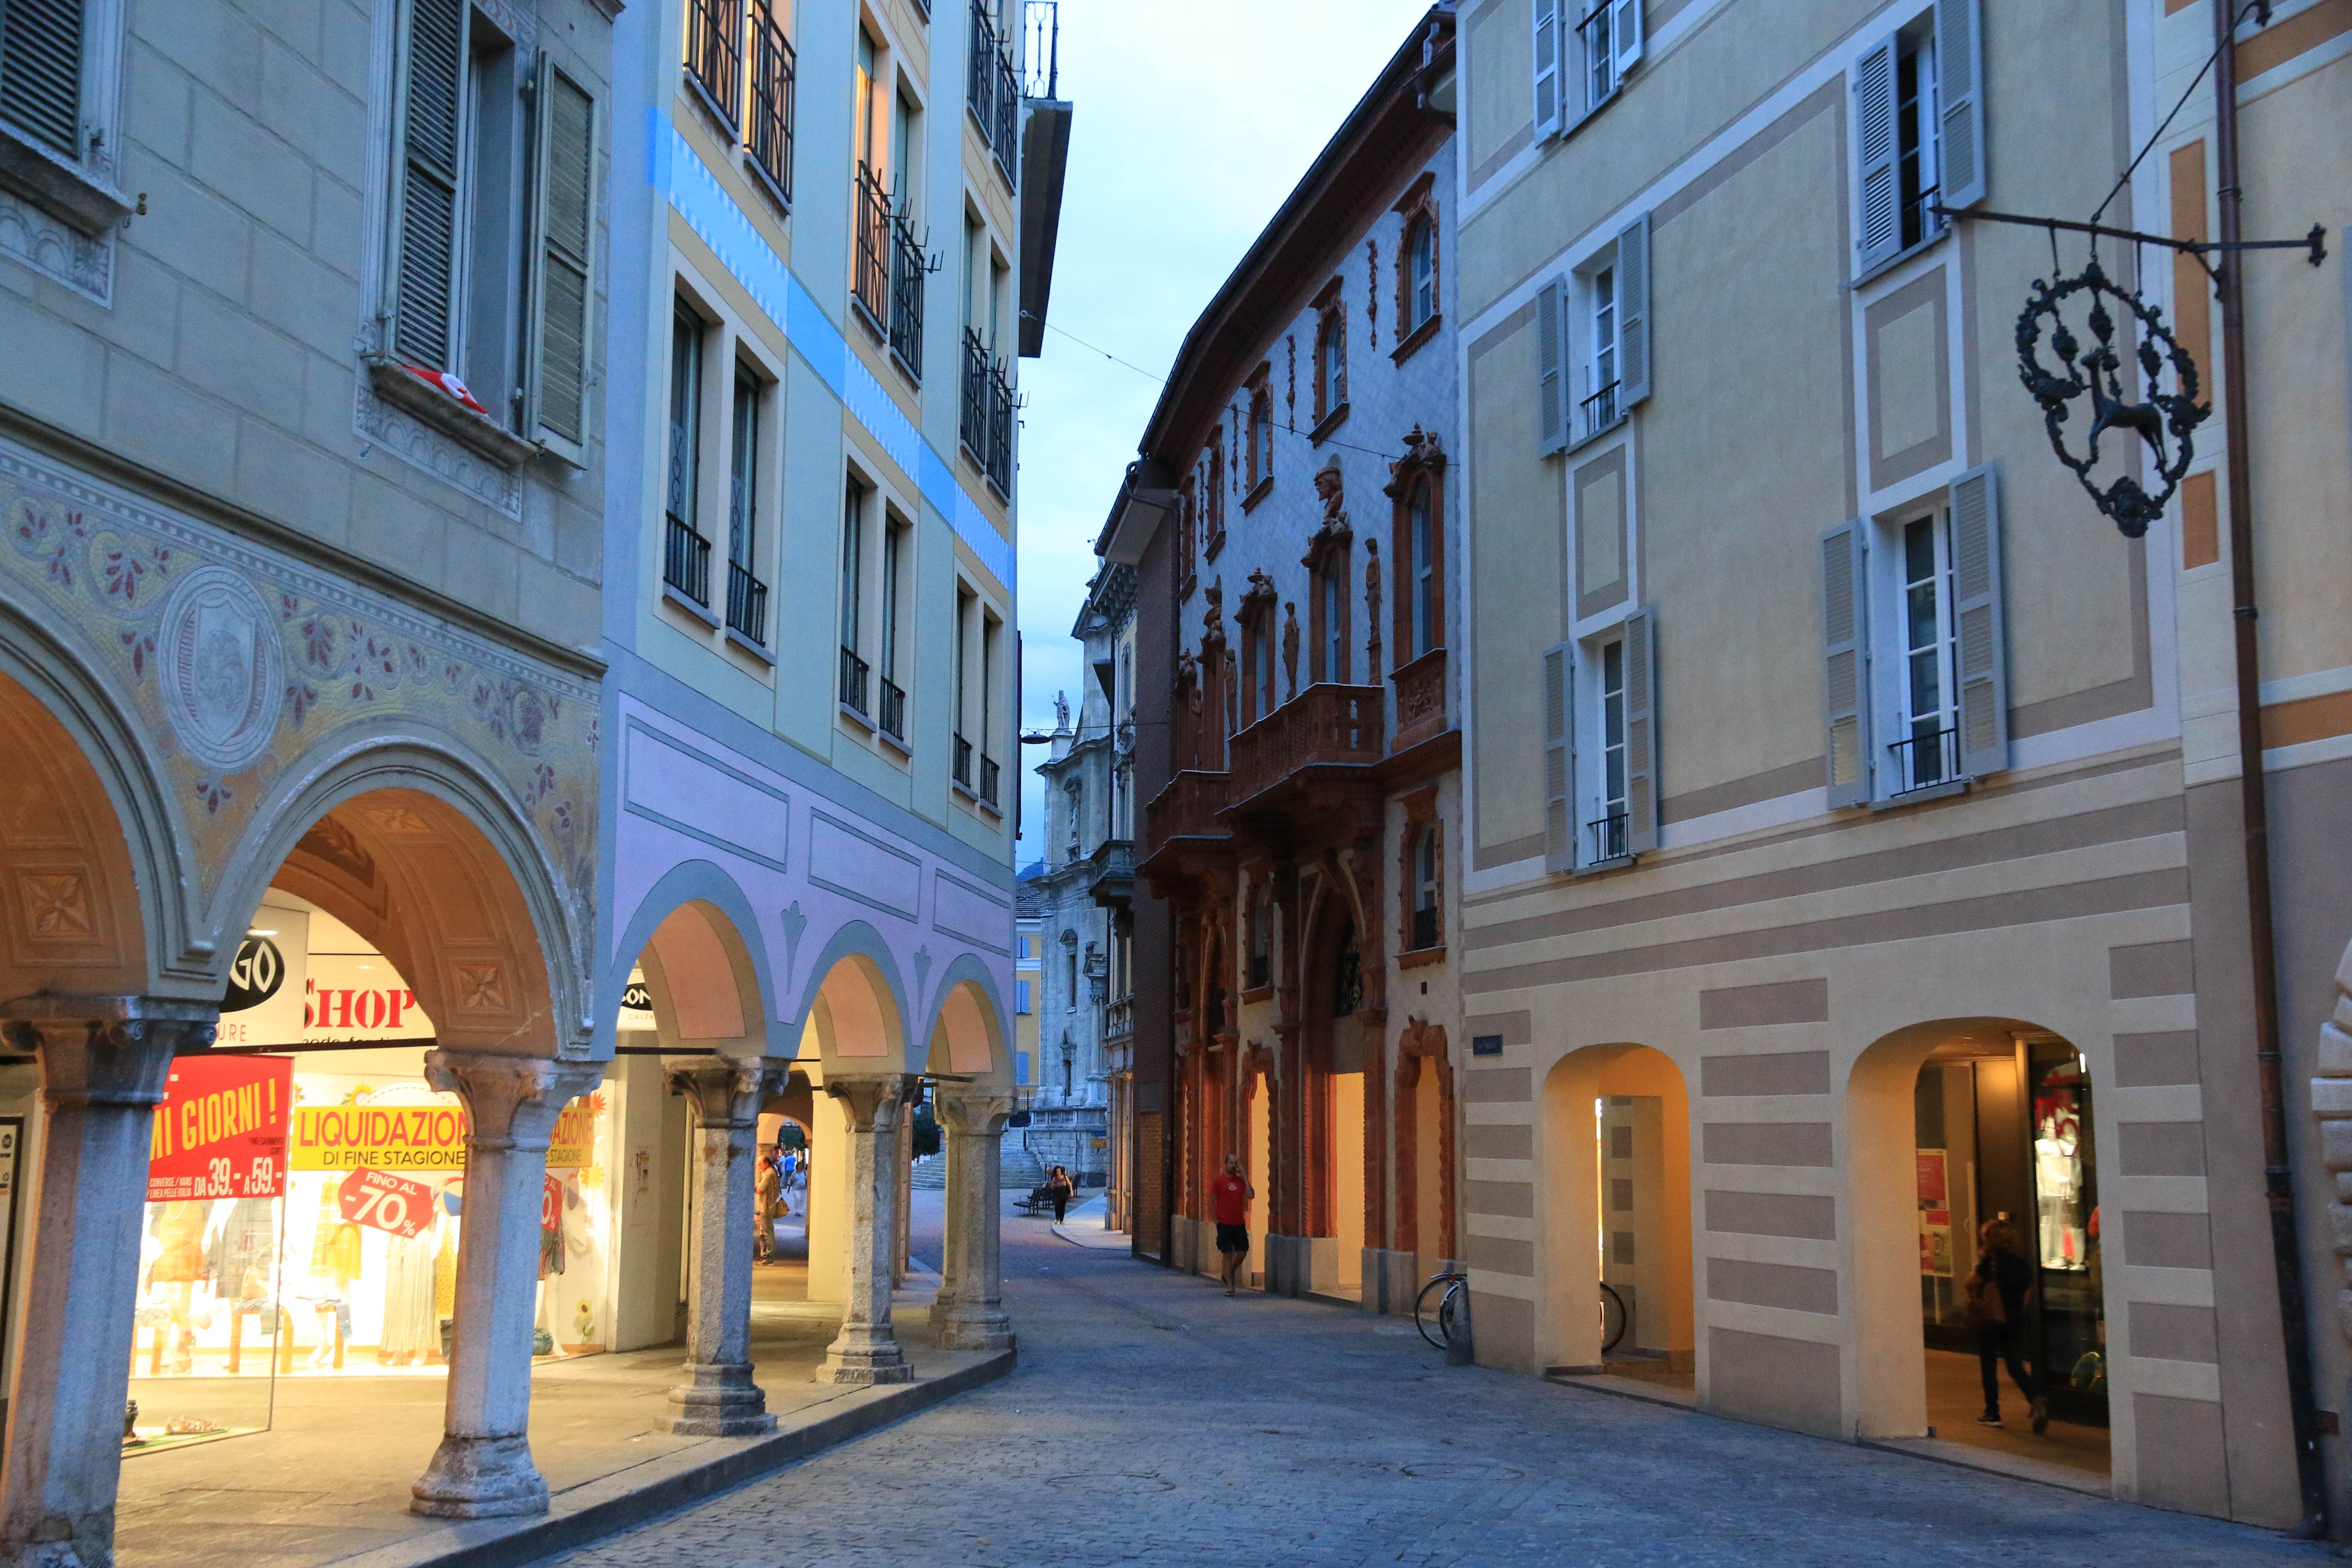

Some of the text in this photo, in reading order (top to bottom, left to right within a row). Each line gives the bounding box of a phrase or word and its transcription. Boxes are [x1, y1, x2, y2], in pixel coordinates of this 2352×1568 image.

[181, 1081, 261, 1151] GIORNI
[550, 1112, 593, 1145] AZIONE
[323, 1150, 466, 1165] DI FINE STAGIONE
[550, 1148, 582, 1163] STAGIONE
[149, 1177, 175, 1188] CONVERSE
[179, 1176, 193, 1187] VANS
[193, 1176, 206, 1197] DA
[243, 1175, 251, 1195] A
[365, 1171, 417, 1196] FINO AL
